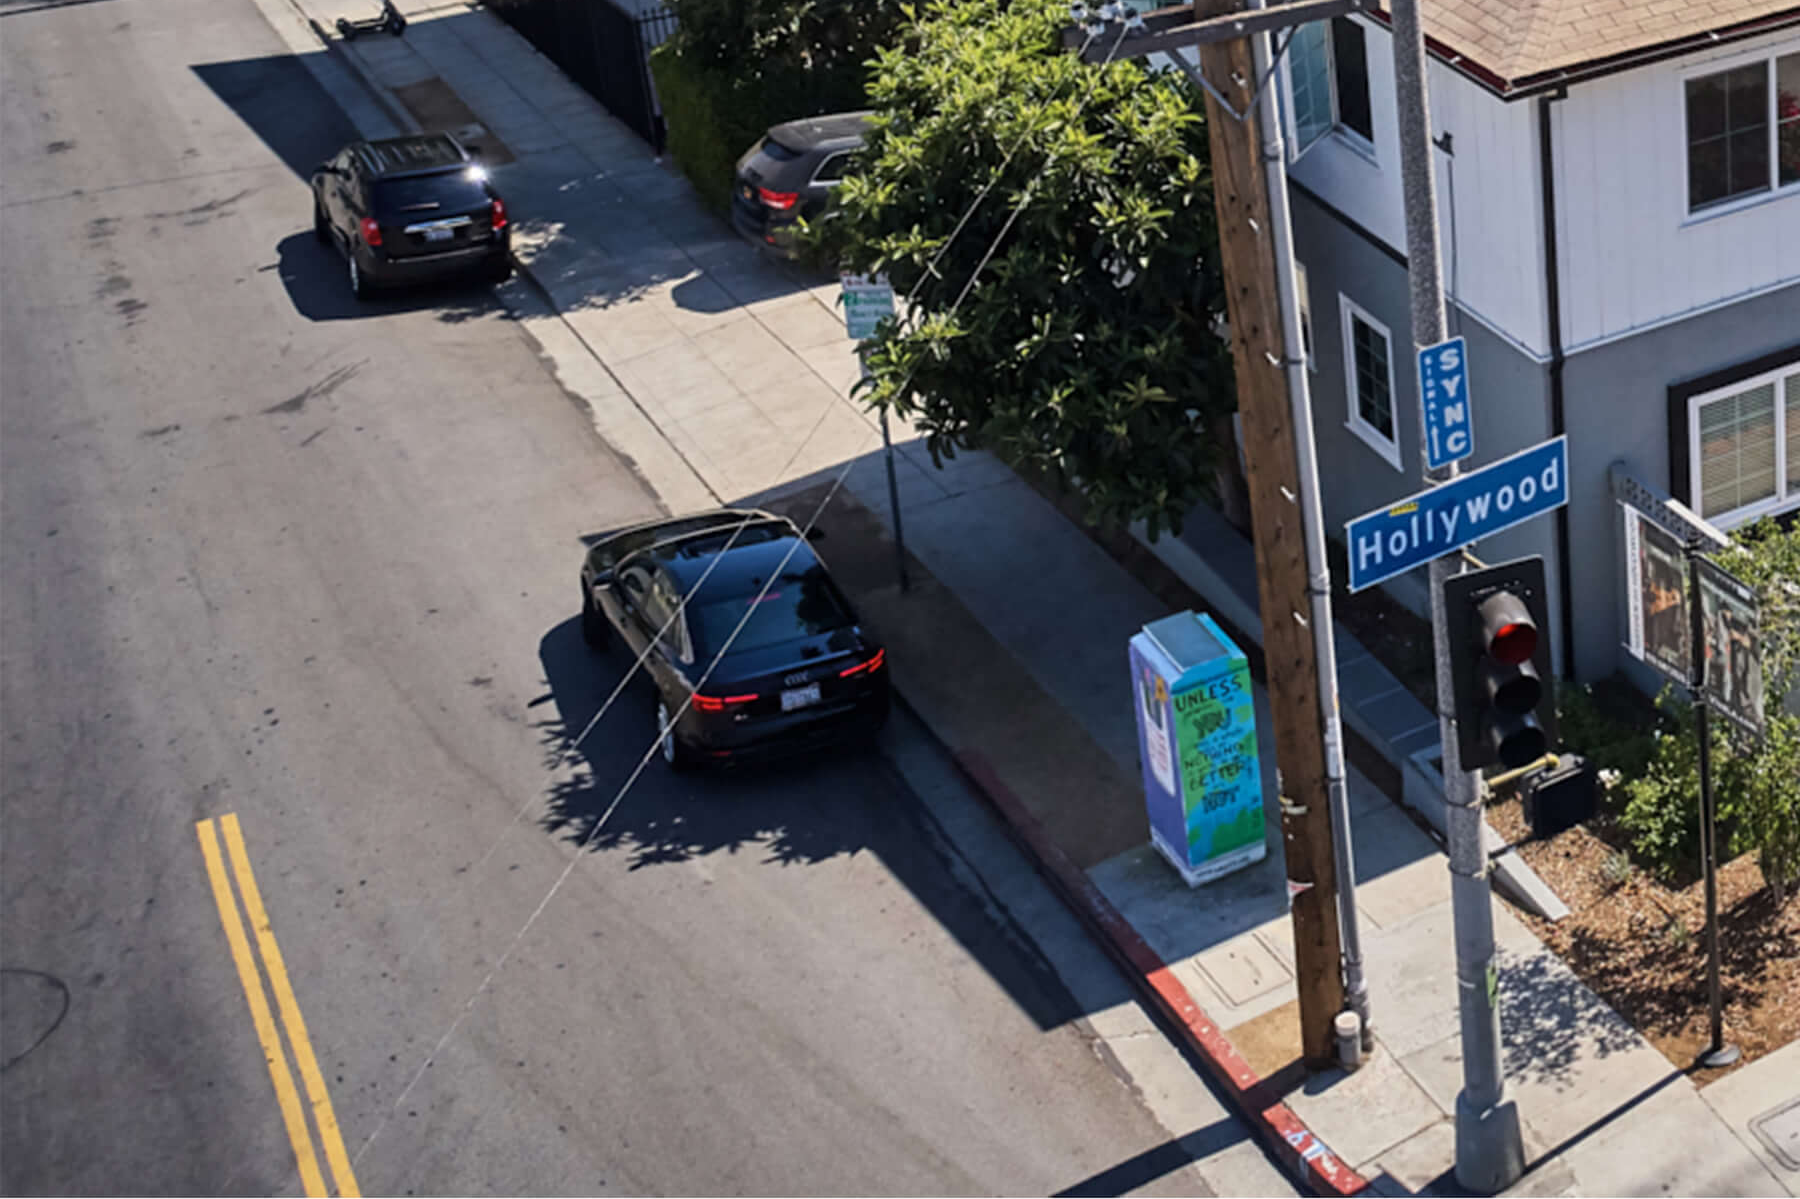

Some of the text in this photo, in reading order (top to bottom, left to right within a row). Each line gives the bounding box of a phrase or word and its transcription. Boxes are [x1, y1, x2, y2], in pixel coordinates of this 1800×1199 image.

[1424, 355, 1437, 422] SIGNAL
[1440, 347, 1467, 453] SYNC
[1358, 457, 1560, 571] Hollywood
[1175, 674, 1242, 712] UNLESS
